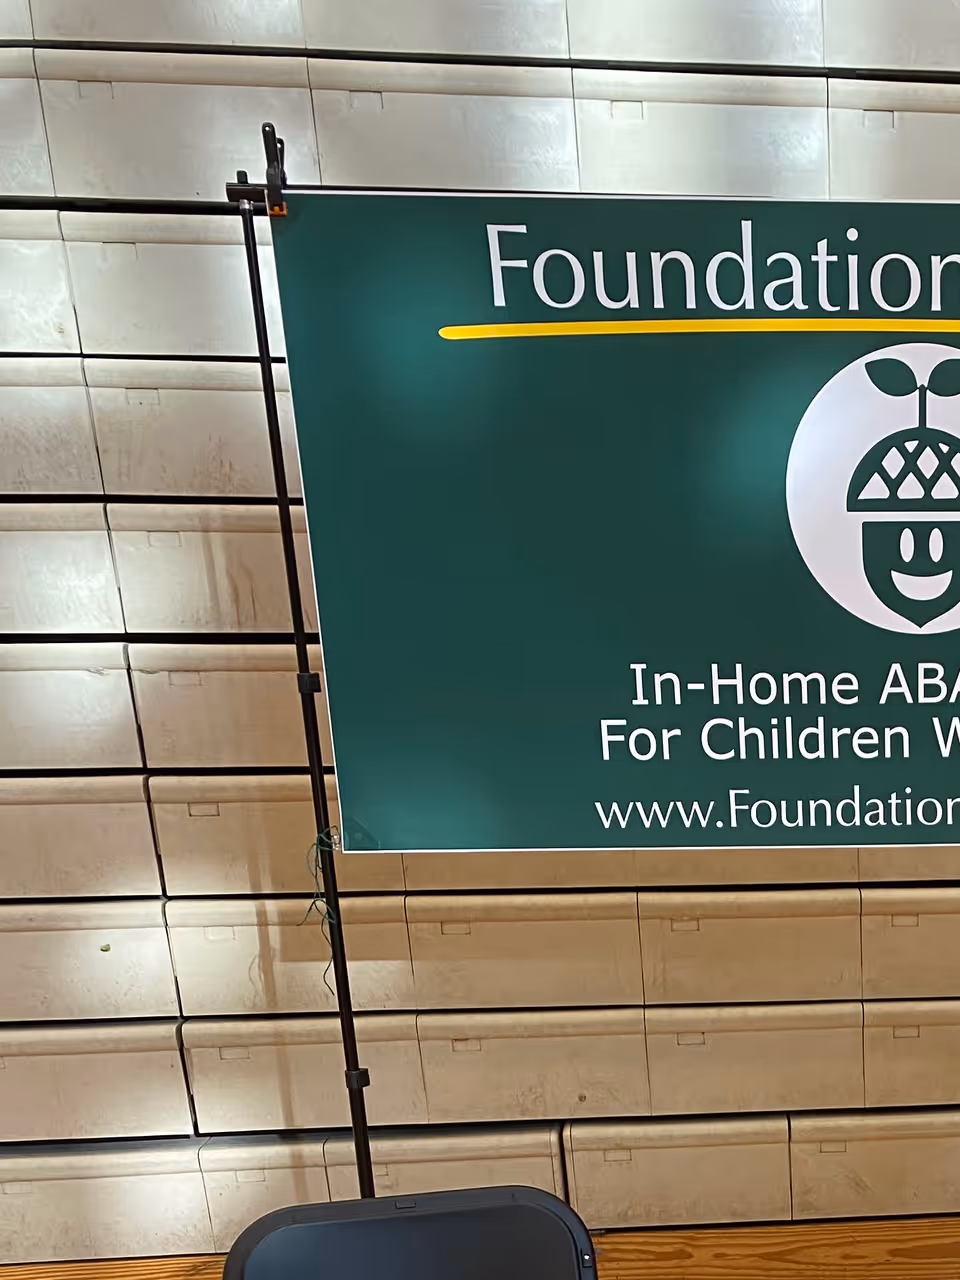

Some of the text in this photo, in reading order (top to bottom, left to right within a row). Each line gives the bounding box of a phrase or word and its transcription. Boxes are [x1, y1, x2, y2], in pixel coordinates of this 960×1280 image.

[629, 662, 859, 706] In-Home
[600, 719, 682, 762] For
[701, 716, 910, 761] Children
